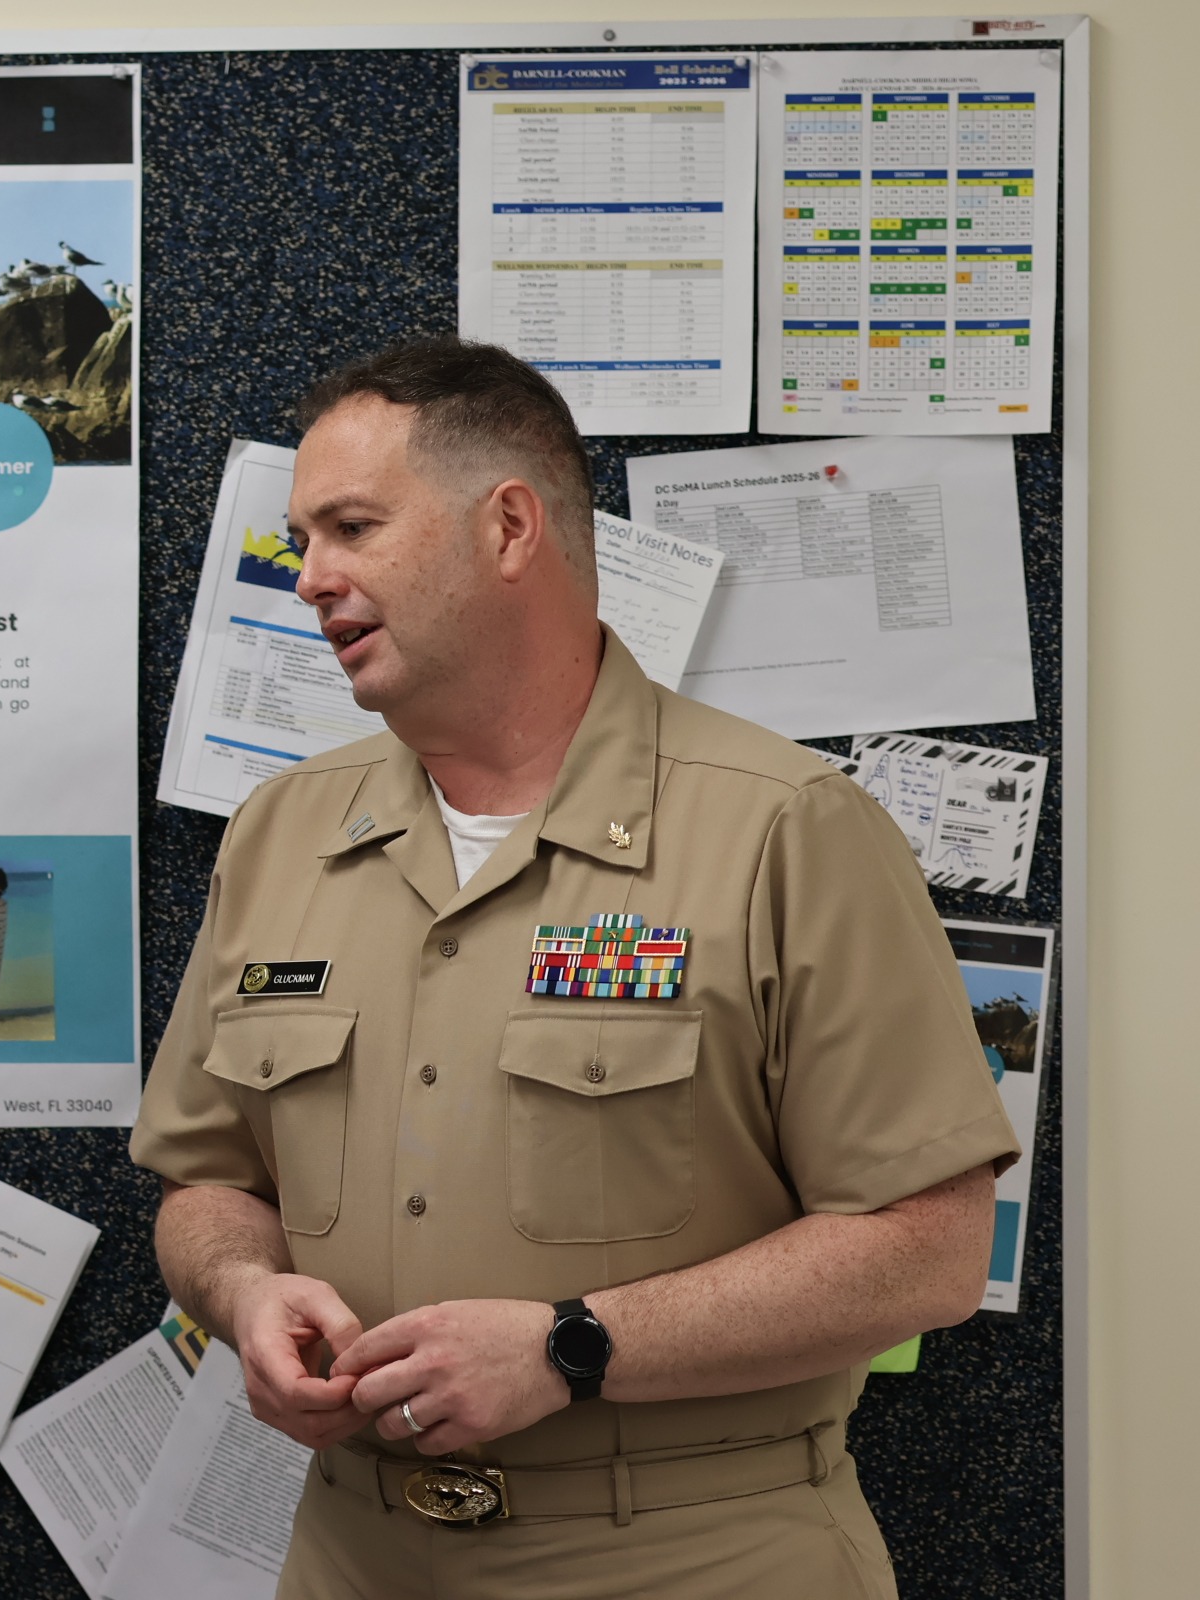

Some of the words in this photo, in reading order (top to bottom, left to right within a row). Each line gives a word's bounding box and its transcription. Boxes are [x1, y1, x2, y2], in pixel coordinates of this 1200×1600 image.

[512, 68, 626, 79] DARNELL-COOKMAN
[655, 65, 679, 75] Bell
[682, 64, 734, 75] Schedule
[659, 77, 688, 85] 2025
[697, 76, 727, 85] 2026
[655, 485, 670, 494] DC
[672, 483, 700, 493] SoMA
[702, 480, 731, 491] Lunch
[733, 475, 779, 487] Schedule
[781, 472, 820, 483] 2025-26
[663, 500, 679, 509] Day
[594, 519, 633, 541] chool
[636, 530, 669, 553] Visit
[671, 543, 715, 568] Notes
[15, 657, 30, 668] at
[0, 677, 29, 689] and
[10, 700, 29, 713] go
[947, 799, 967, 807] DEAR
[273, 974, 315, 983] GLUCKMAN
[3, 1100, 44, 1114] West,
[48, 1100, 63, 1112] FL
[66, 1099, 113, 1113] 33040
[146, 1346, 172, 1380] UPDATES
[170, 1380, 183, 1396] FOR
